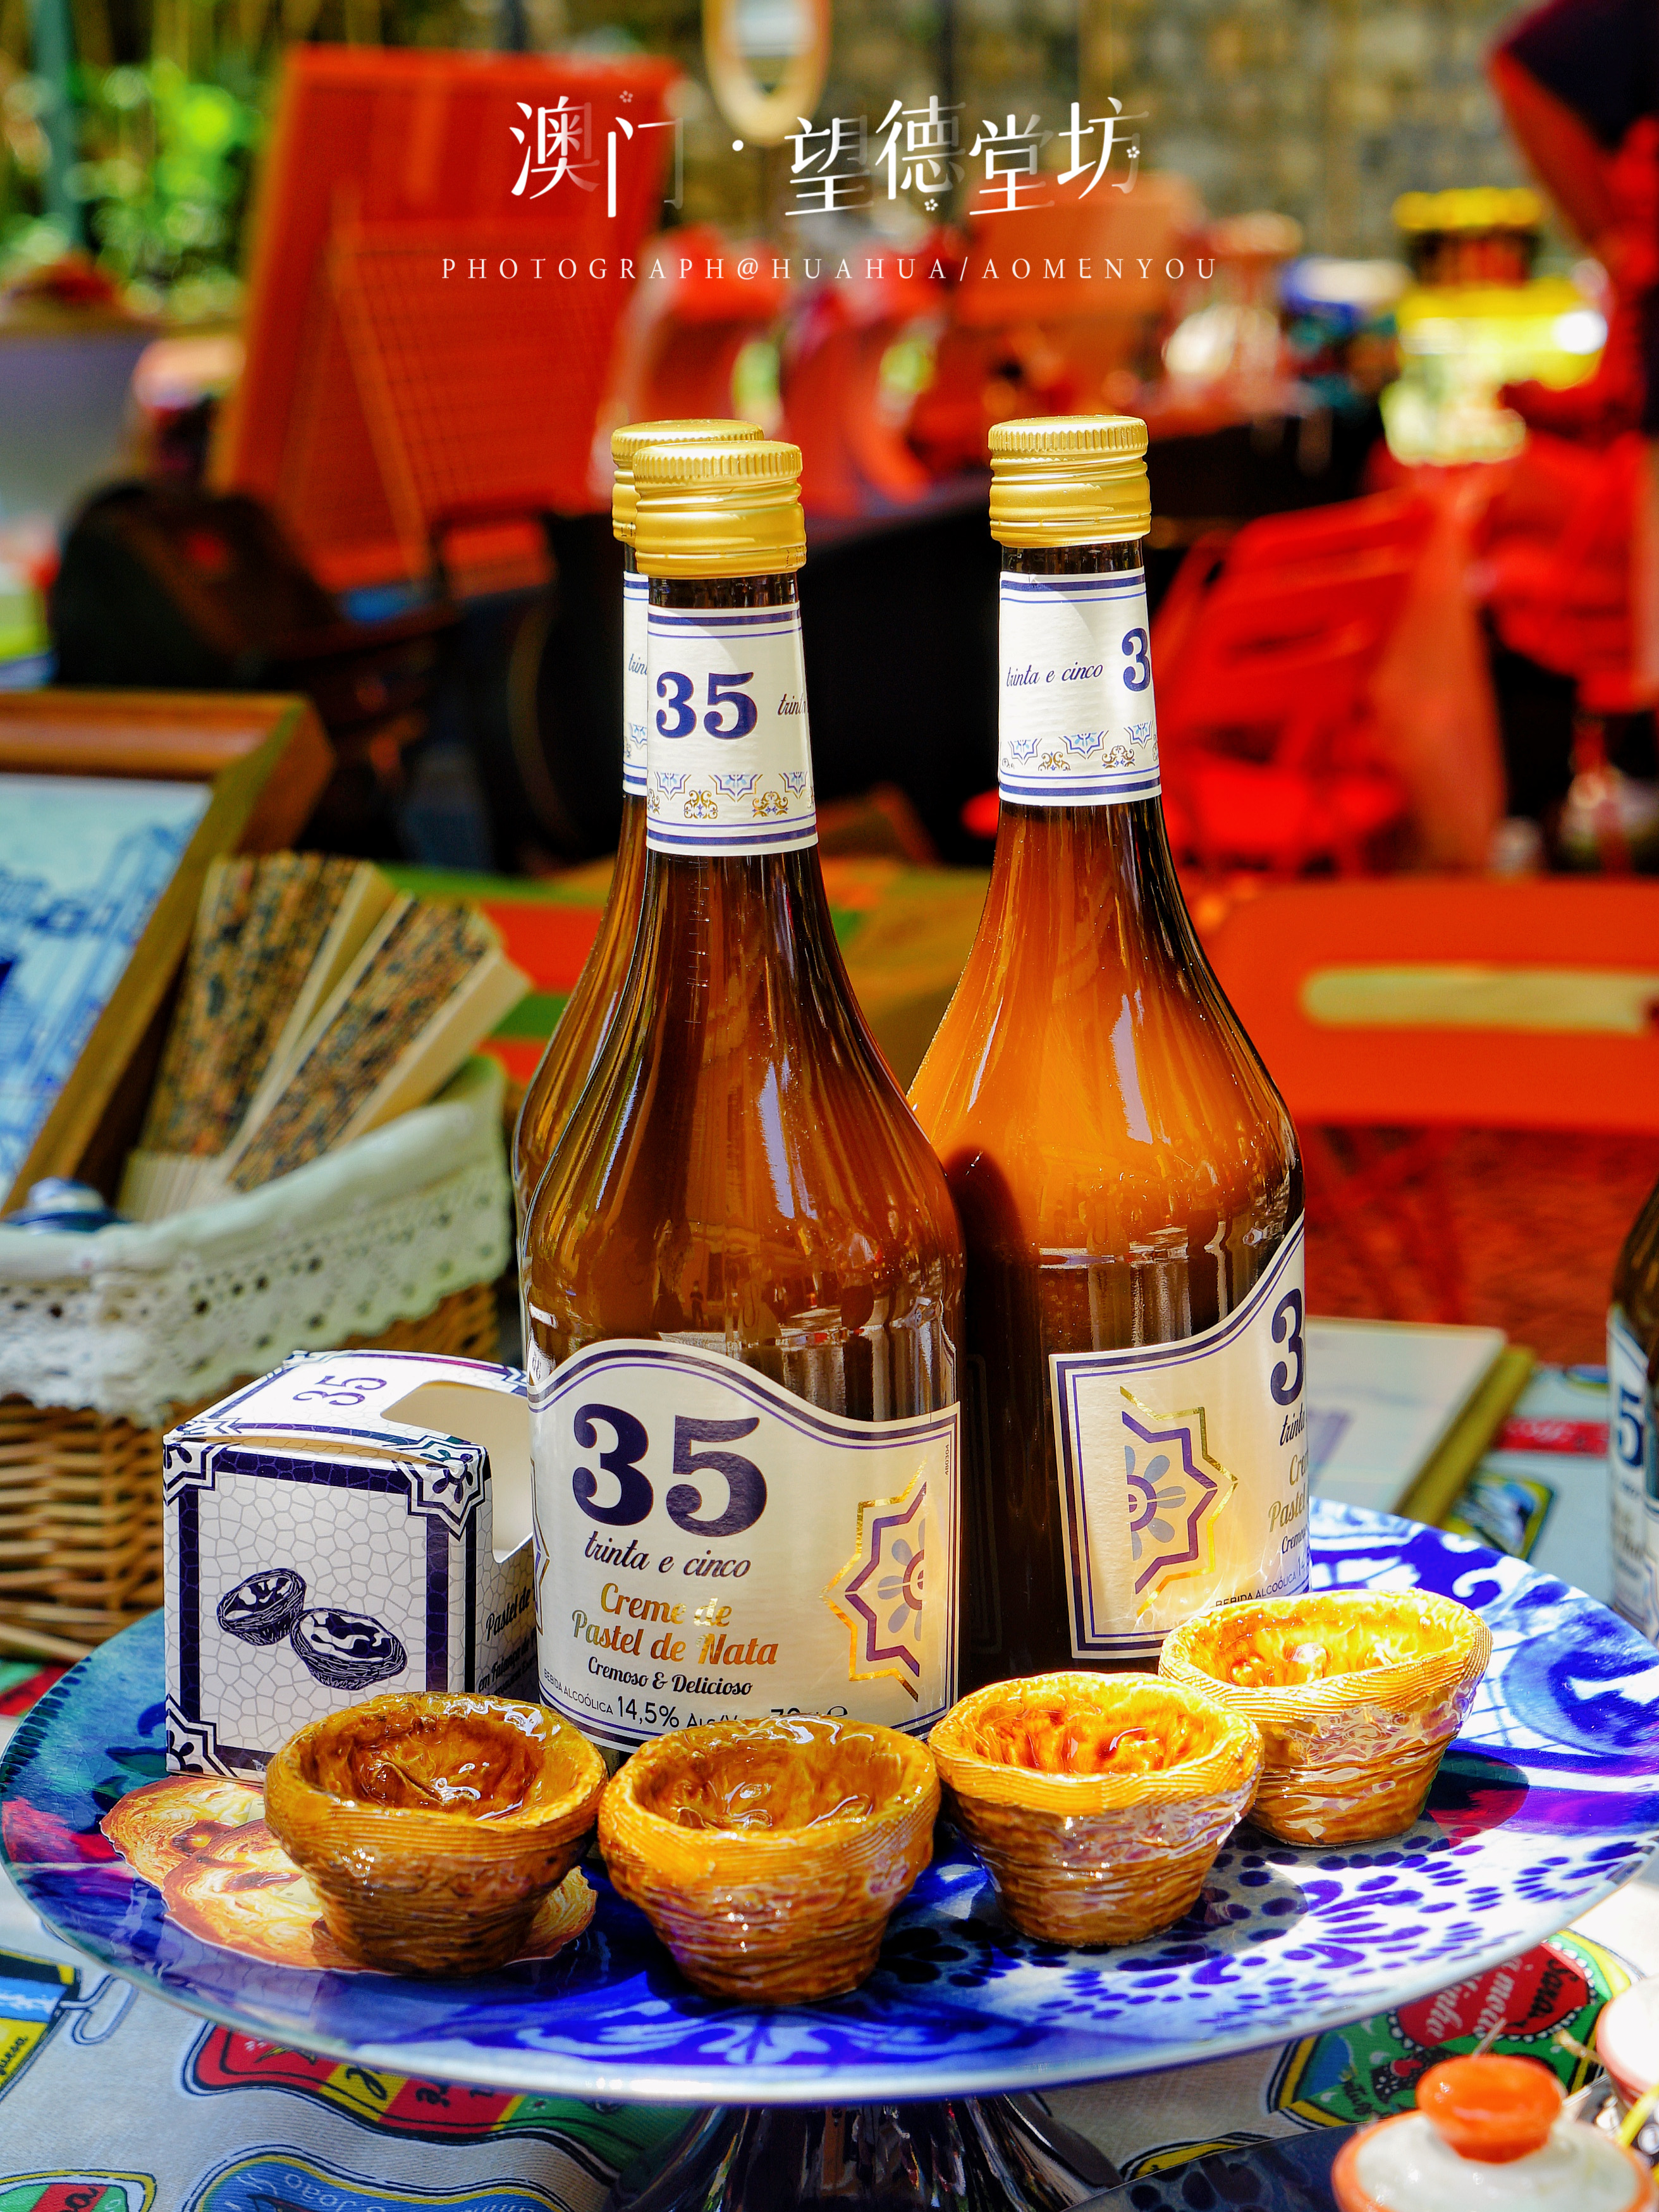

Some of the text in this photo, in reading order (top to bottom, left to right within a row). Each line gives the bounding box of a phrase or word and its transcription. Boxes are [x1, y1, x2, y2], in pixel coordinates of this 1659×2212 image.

[1006, 661, 1103, 687] trinta e cinco
[656, 671, 758, 740] 35
[572, 1403, 768, 1537] 35
[585, 1530, 751, 1578] trinta e cinco
[600, 1583, 732, 1627] Creme de
[1256, 1571, 1296, 1599] ALCOÓLICA
[486, 1593, 518, 1642] Pastel
[572, 1609, 645, 1656] Pastel
[651, 1636, 685, 1662] de
[696, 1633, 779, 1666] Nata
[544, 1668, 563, 1693] BEBIDA
[564, 1685, 613, 1715] ALCOÓLICA
[618, 1696, 680, 1728] 14,5%
[588, 1656, 753, 1695] Cremoso & Delicioso
